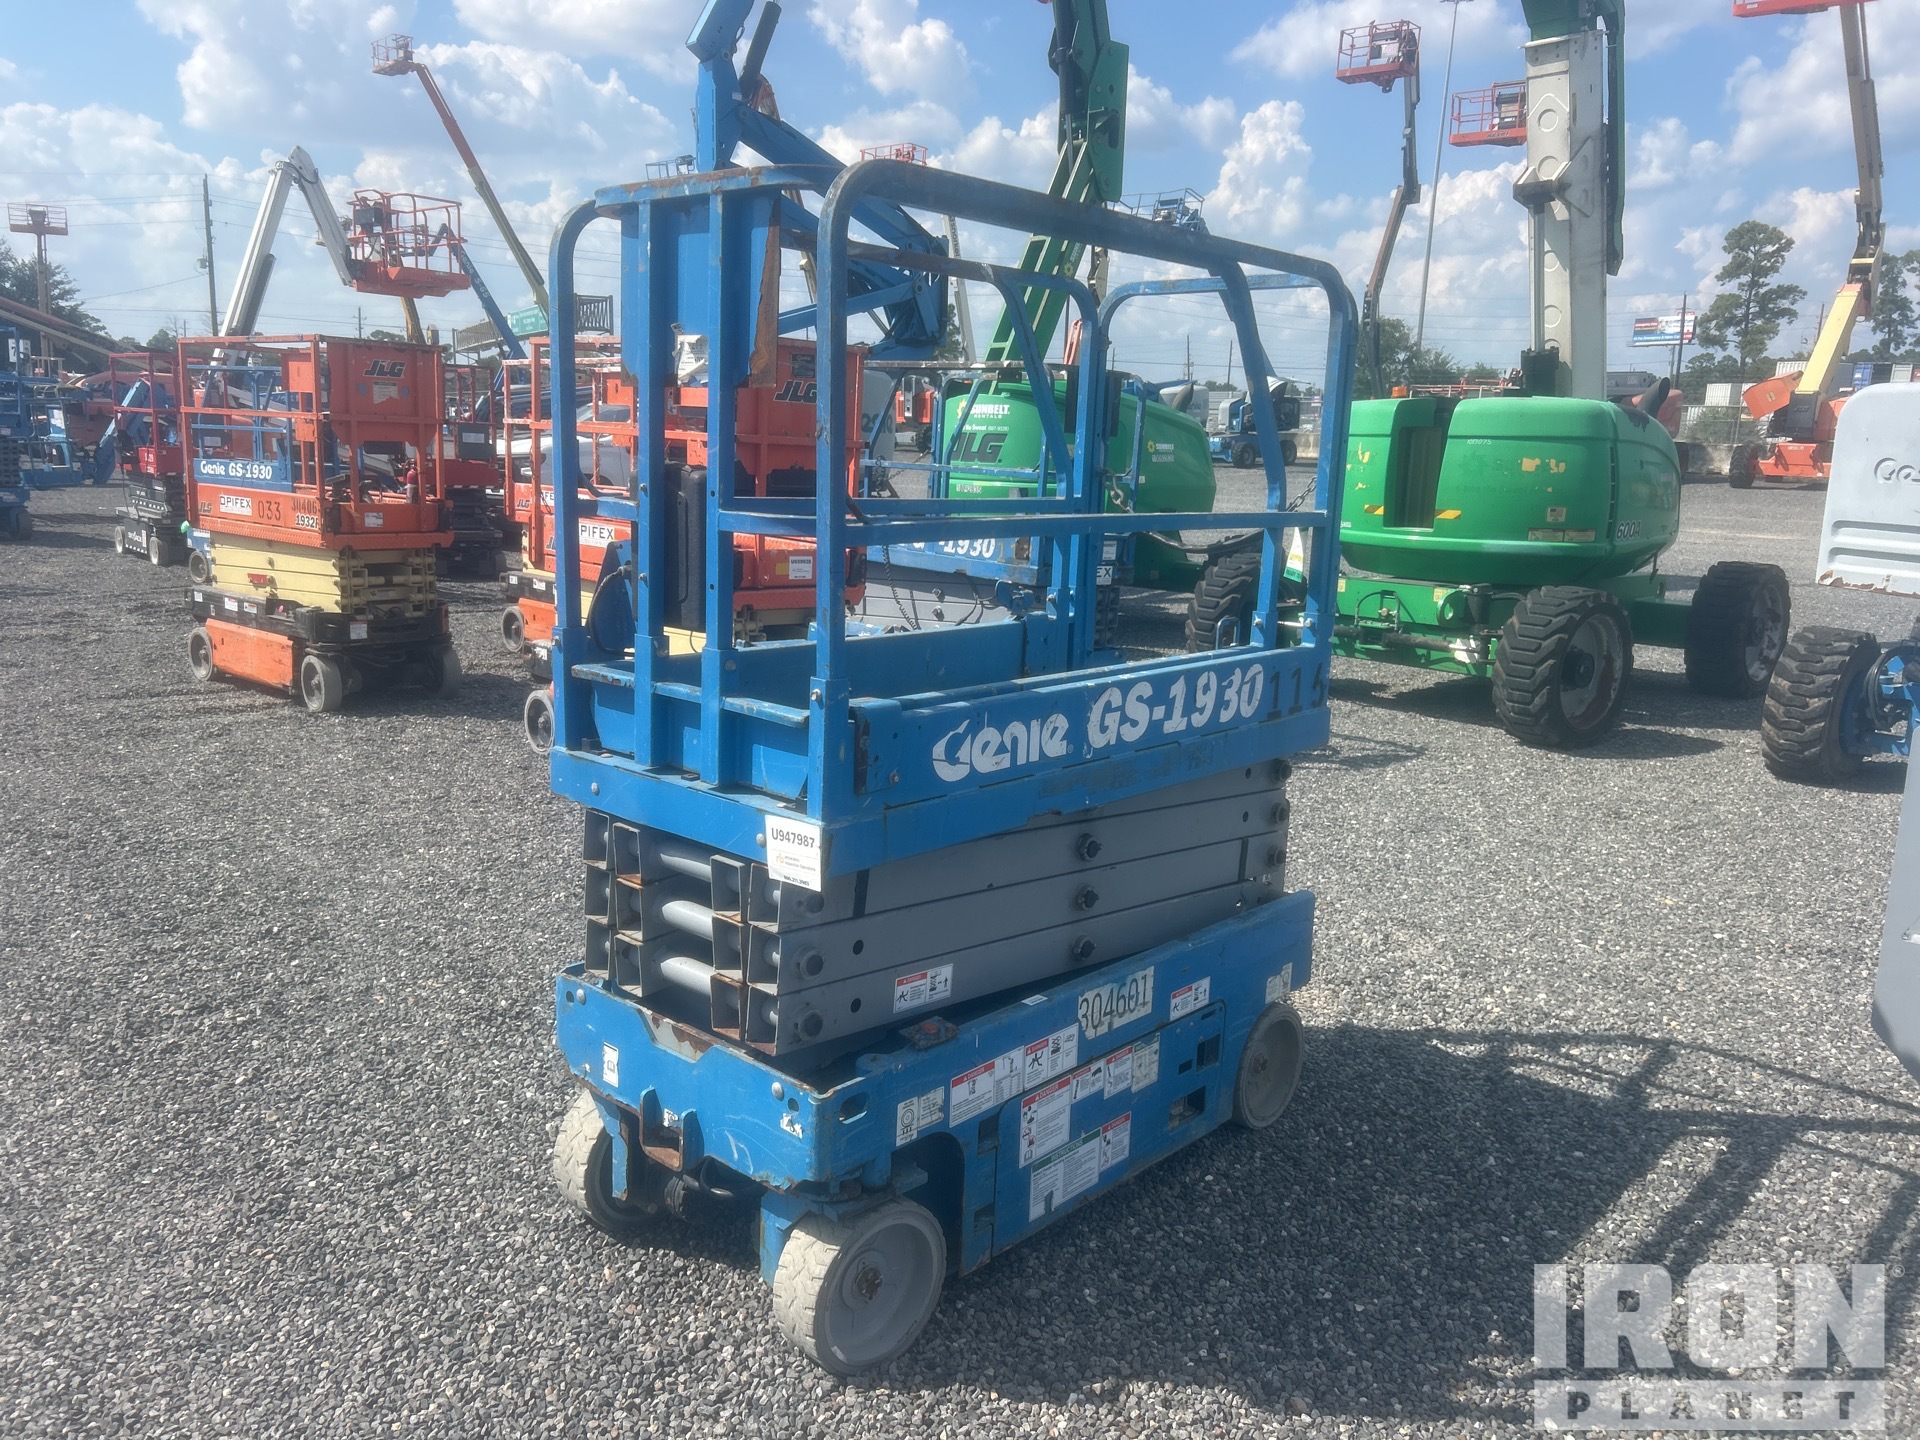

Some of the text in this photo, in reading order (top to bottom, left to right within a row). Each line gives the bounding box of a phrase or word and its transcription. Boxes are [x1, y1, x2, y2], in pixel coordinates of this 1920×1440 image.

[363, 359, 406, 378] JLG
[773, 380, 817, 404] JLG
[951, 433, 1008, 464] JLG
[200, 461, 272, 479] Genie GS-1930
[257, 500, 281, 520] 033
[933, 713, 1069, 782] Genie
[1087, 664, 1264, 750] GS-1930
[771, 827, 815, 848] U947987
[1079, 974, 1148, 1031] 304601
[1031, 1040, 1047, 1051] DANGER
[967, 1066, 985, 1080] DANGER
[1039, 1084, 1059, 1098] DANGER
[1051, 1139, 1083, 1161] INSTRUCTIONS
